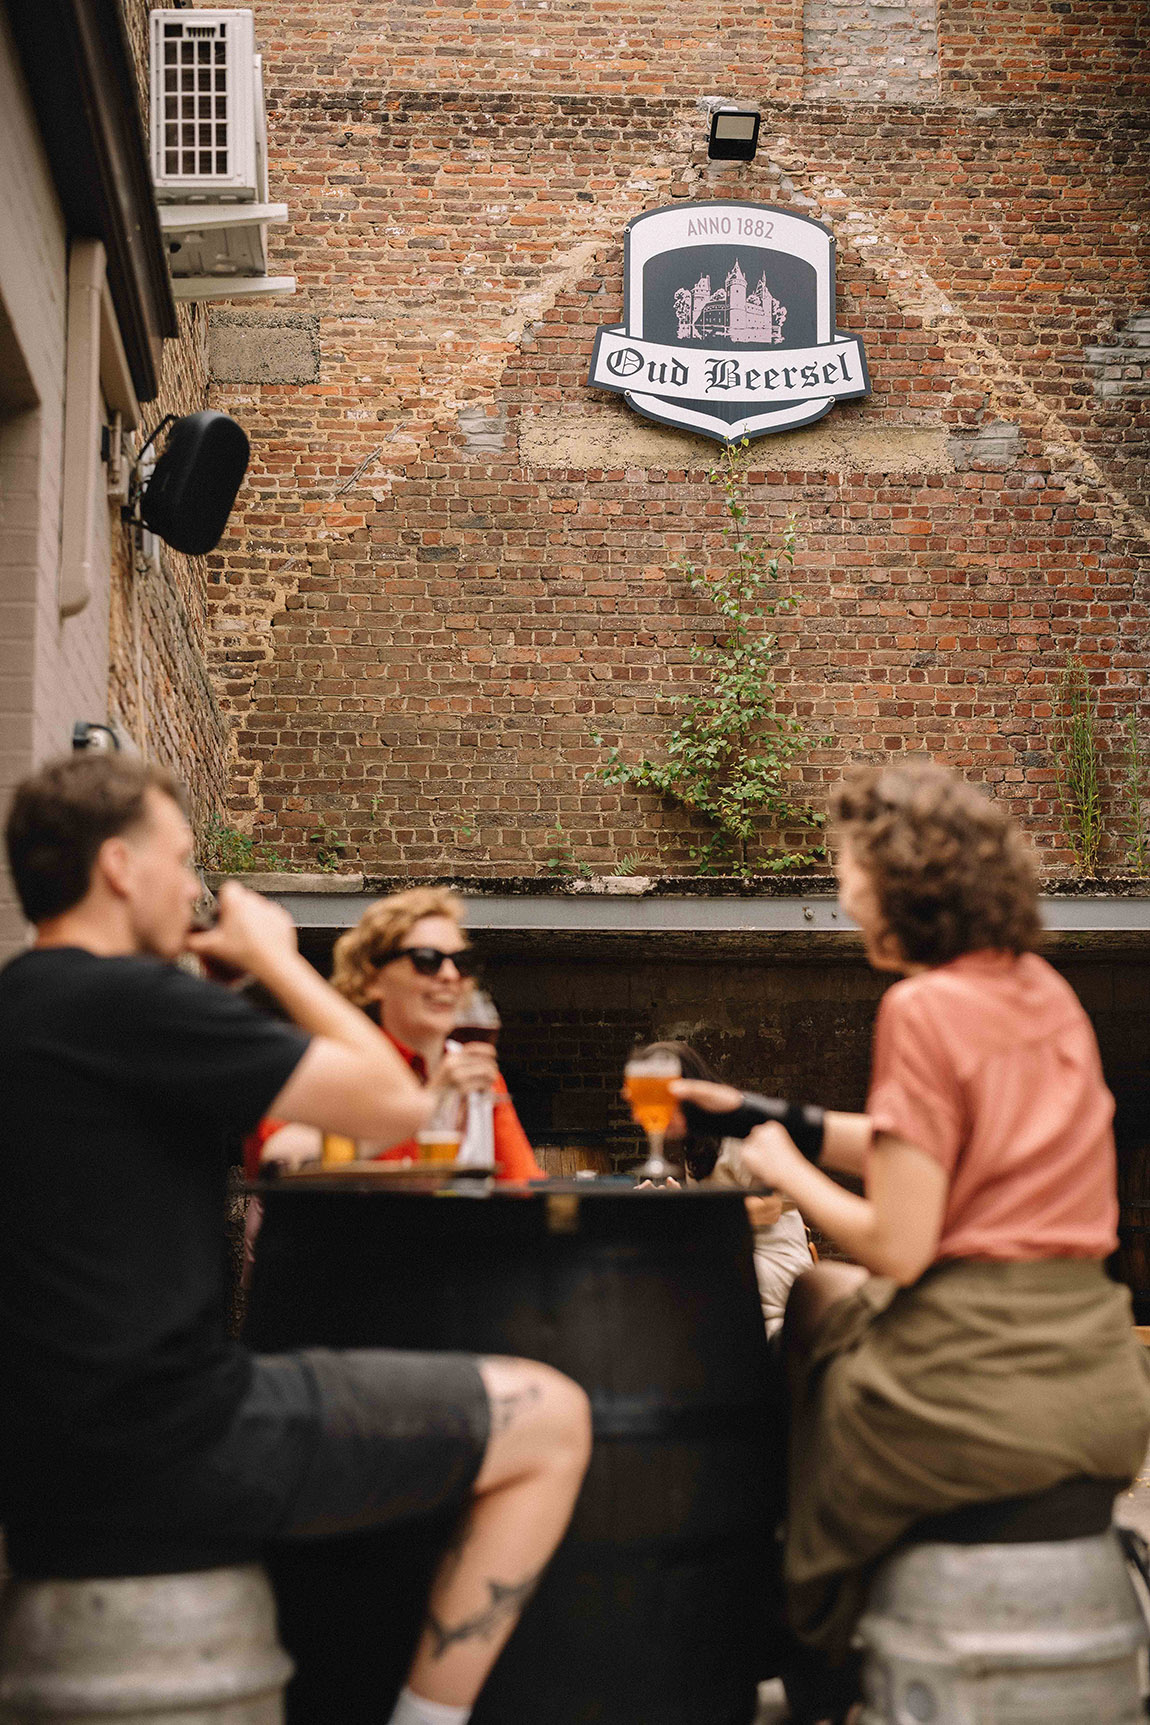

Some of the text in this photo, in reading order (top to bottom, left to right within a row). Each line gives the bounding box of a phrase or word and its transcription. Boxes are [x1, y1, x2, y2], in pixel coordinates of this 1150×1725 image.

[687, 216, 775, 240] ANNO 1882
[606, 347, 853, 394] Oud Beersel
